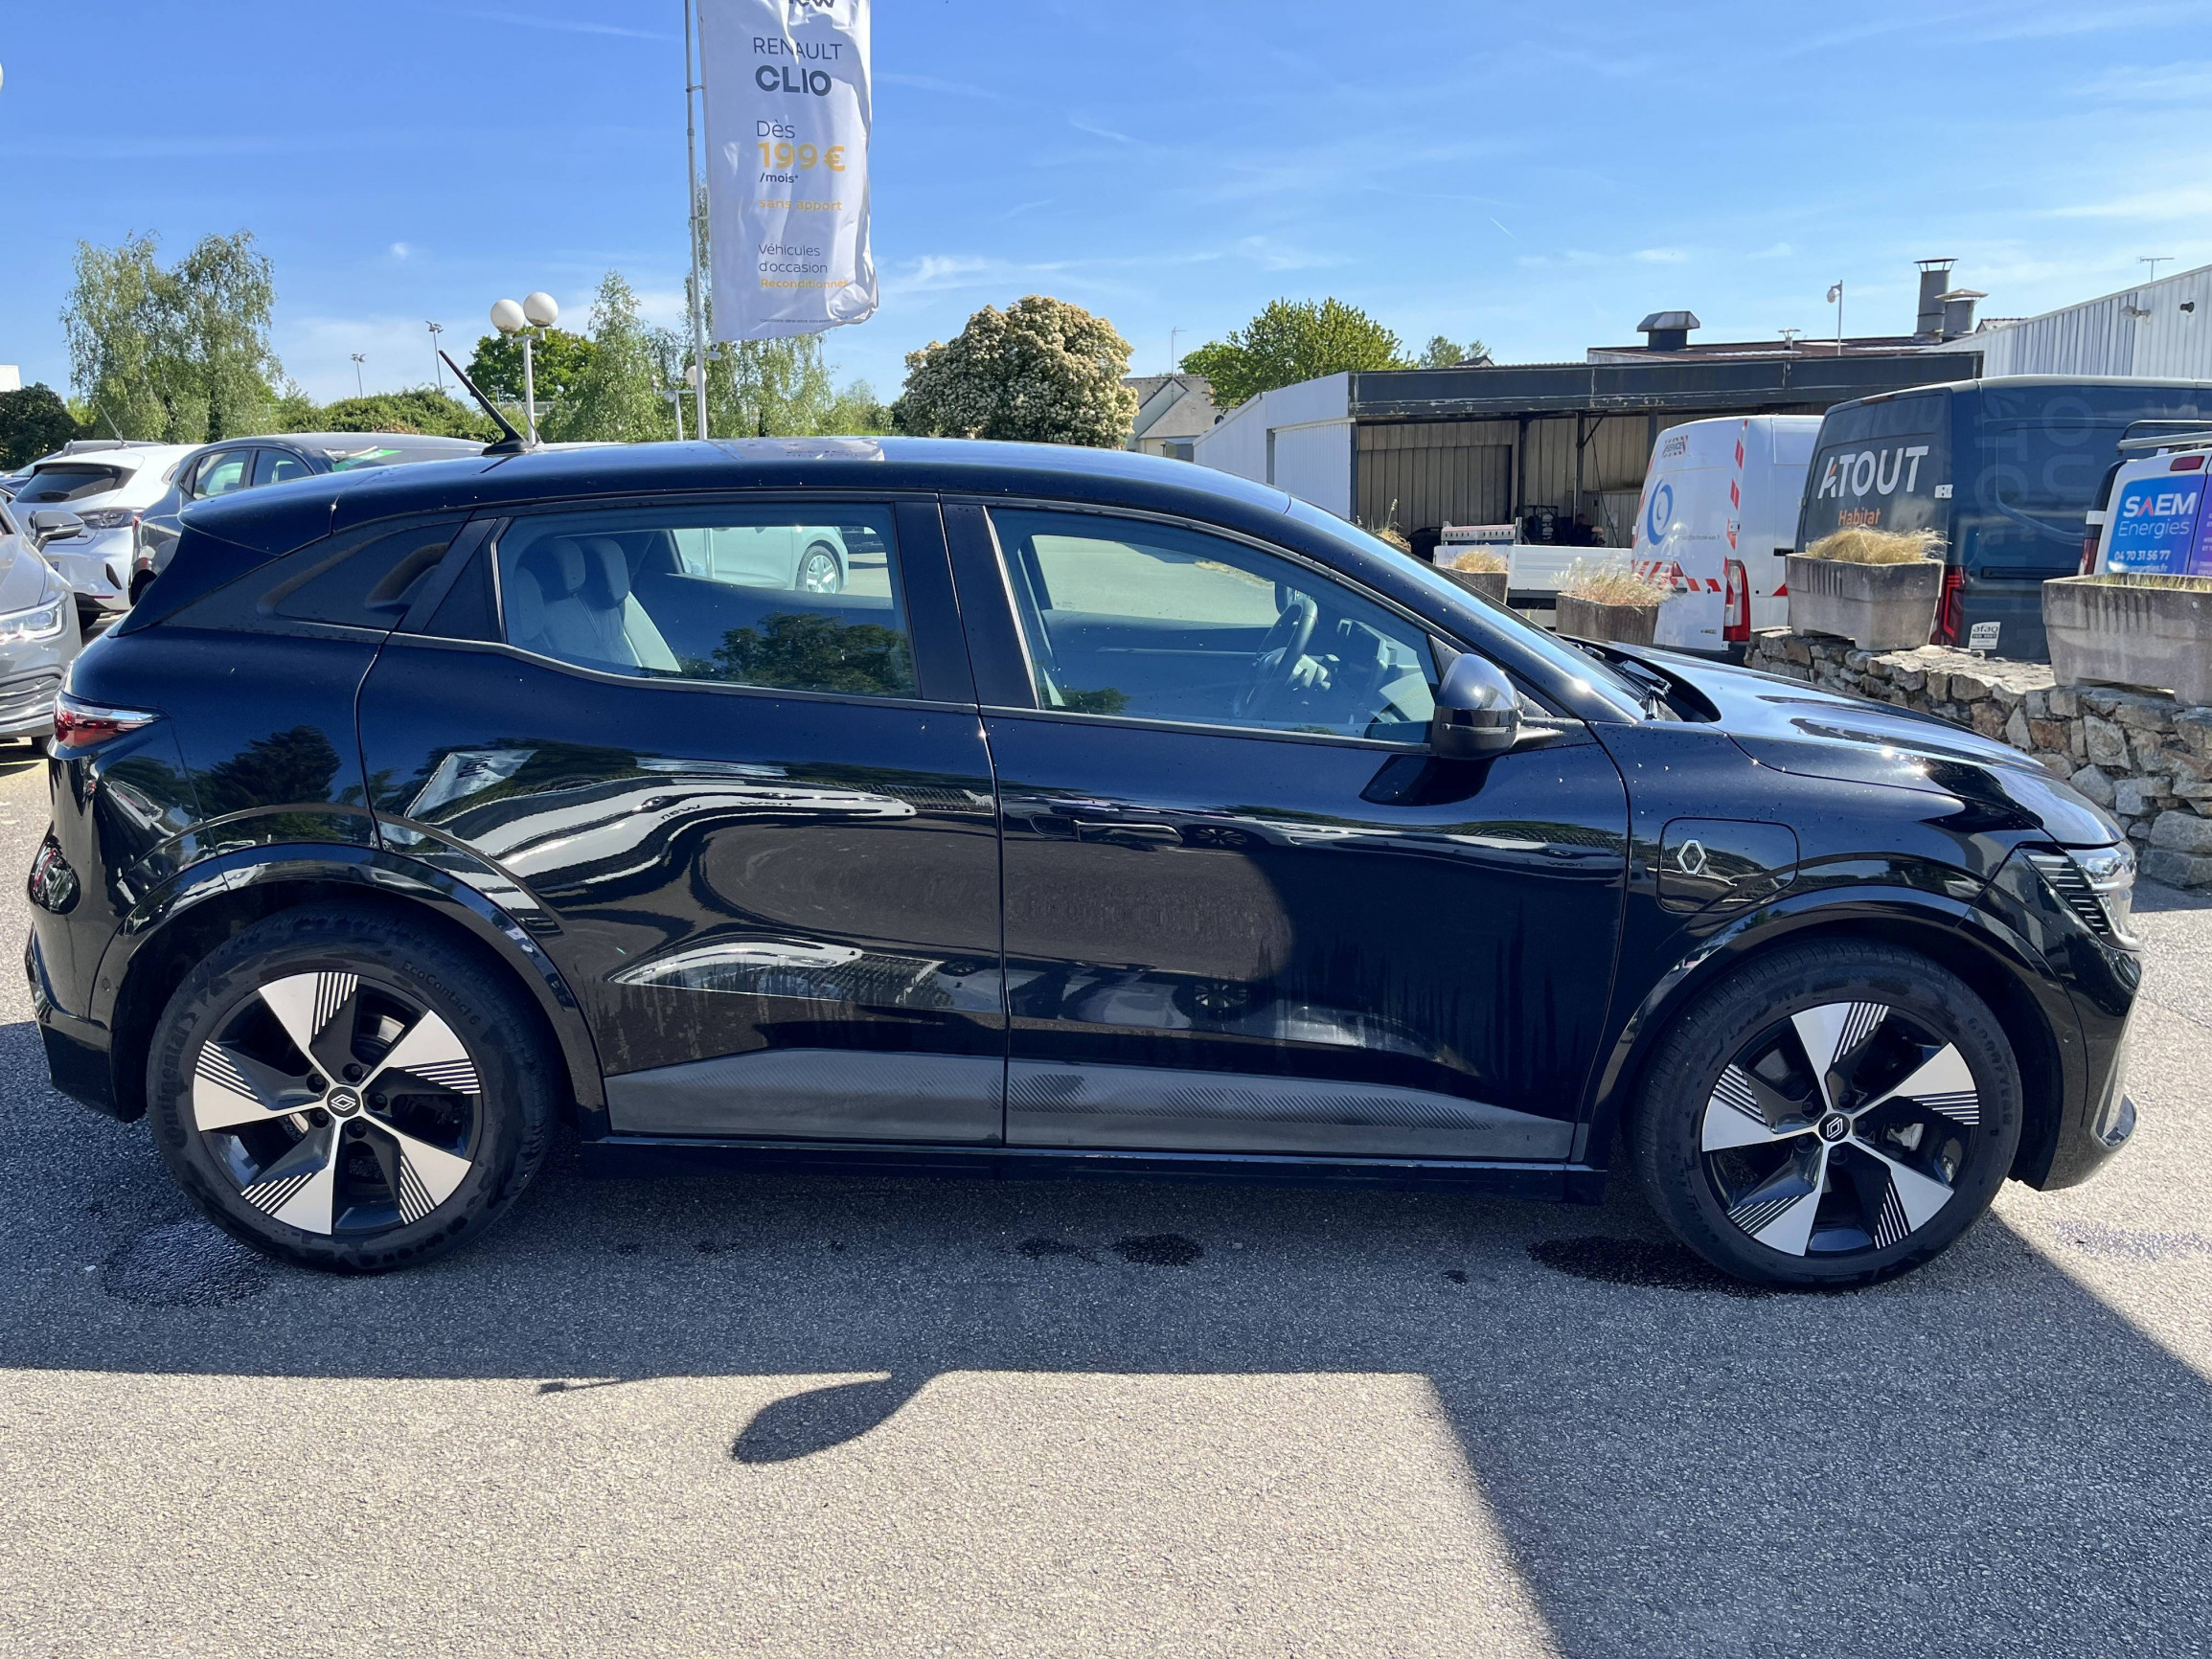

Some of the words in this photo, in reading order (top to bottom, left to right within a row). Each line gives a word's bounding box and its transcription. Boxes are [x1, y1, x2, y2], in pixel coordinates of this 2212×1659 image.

[753, 36, 843, 59] RENAULT
[755, 65, 832, 96] CLIO
[757, 119, 795, 139] Dès
[758, 199, 791, 209] sans
[796, 200, 842, 214] apport
[758, 243, 821, 257] Véhicules
[759, 261, 828, 274] d'occasion
[761, 278, 849, 288] Reconditionnés
[1817, 445, 1929, 499] ATOUT
[2123, 491, 2197, 518] SAEM
[1837, 507, 1881, 526] Habitat
[2118, 518, 2190, 539] Energies
[2114, 551, 2125, 560] 04
[2127, 550, 2136, 560] 70
[2137, 550, 2146, 560] 31
[2147, 550, 2158, 560] 56
[2159, 550, 2172, 560] 77
[401, 959, 472, 1017] EcoContact
[468, 1014, 481, 1026] 6
